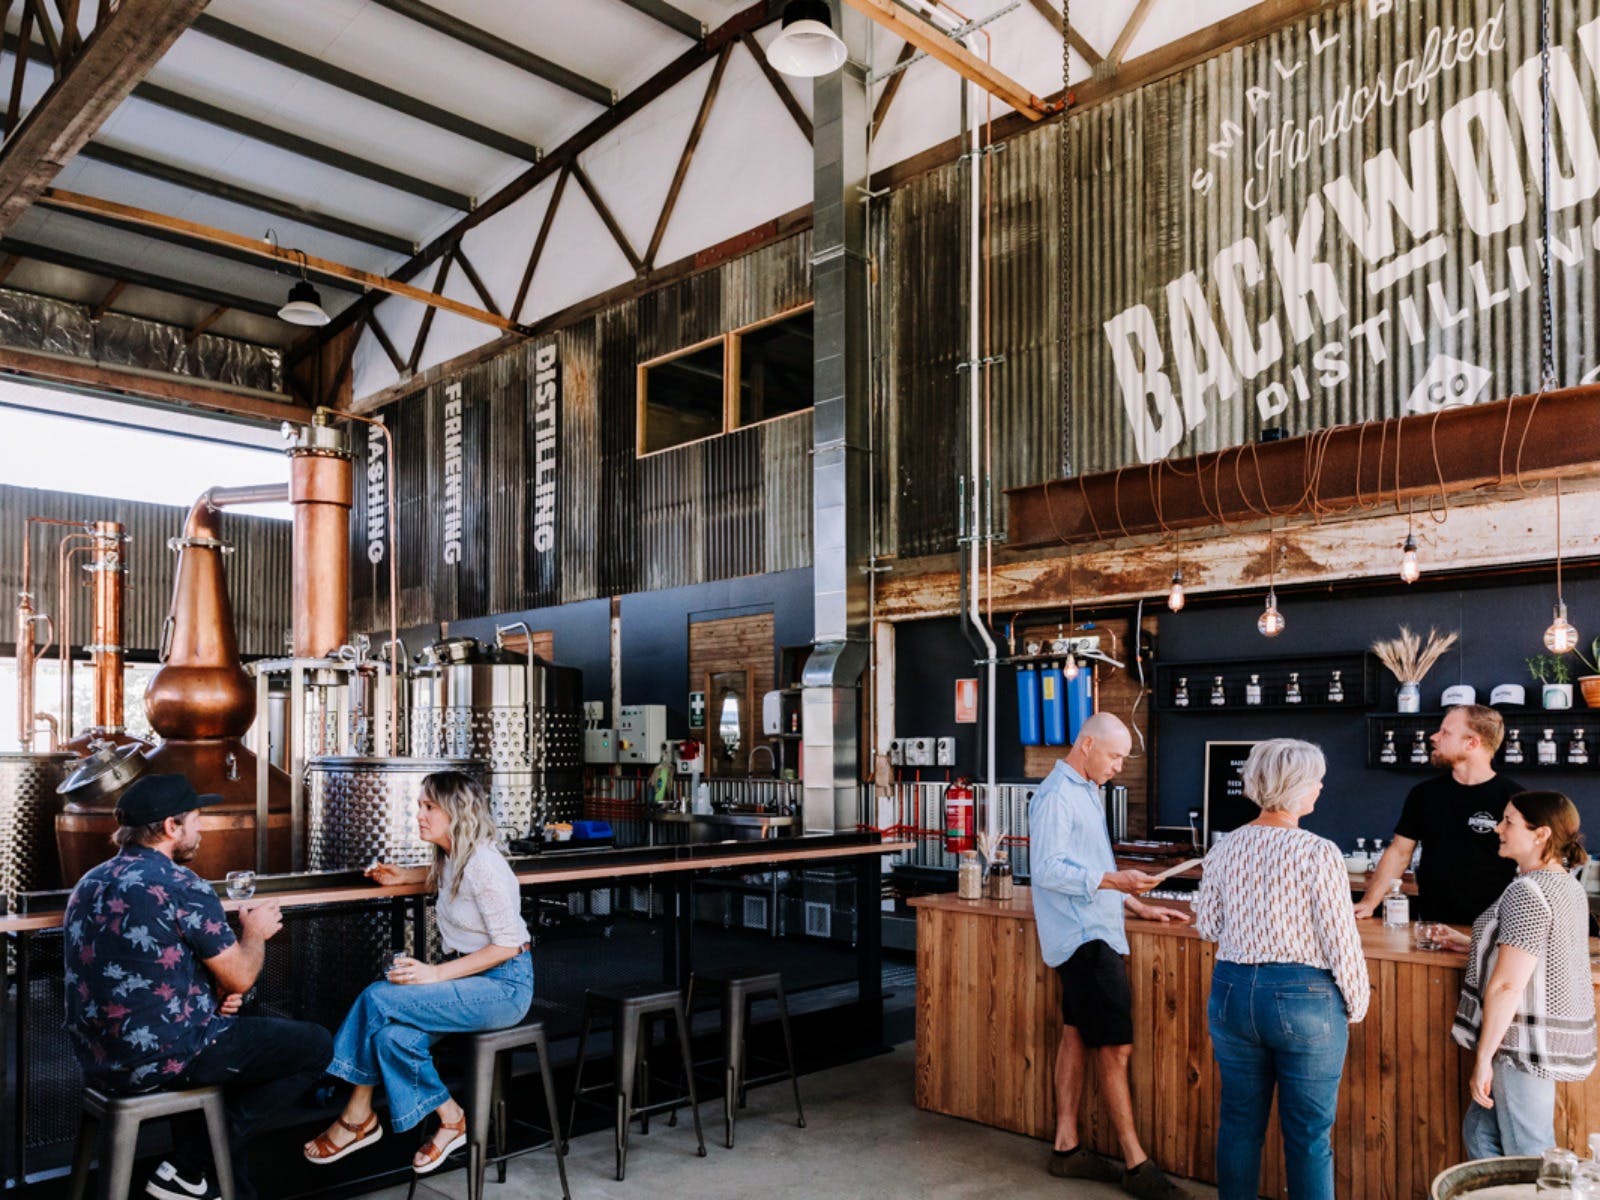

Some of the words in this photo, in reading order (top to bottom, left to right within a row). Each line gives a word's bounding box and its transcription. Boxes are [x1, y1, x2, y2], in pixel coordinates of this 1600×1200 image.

[1191, 27, 1340, 196] SMALL
[1245, 6, 1506, 211] Handcrafted
[1103, 16, 1600, 464] BACKWOO
[1256, 217, 1600, 421] DISTILLIN
[444, 382, 462, 565] FERMENTING
[534, 344, 557, 553] DISTILLING
[1427, 373, 1469, 405] CO
[367, 413, 385, 564] MASHING
